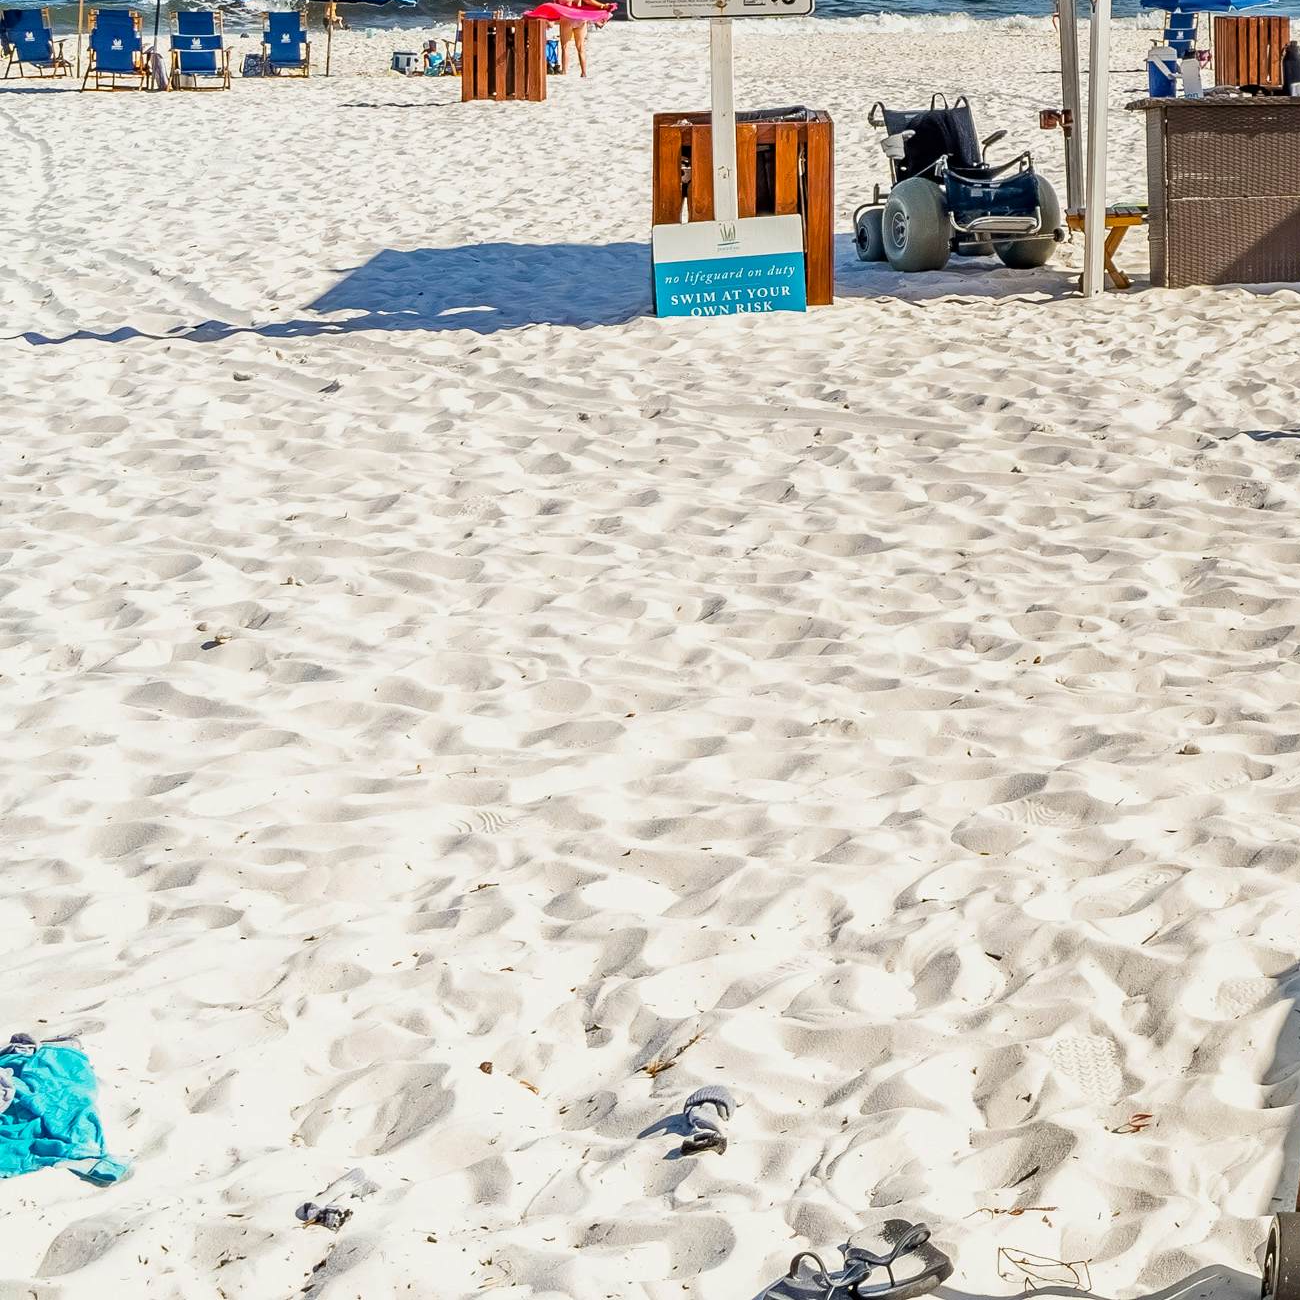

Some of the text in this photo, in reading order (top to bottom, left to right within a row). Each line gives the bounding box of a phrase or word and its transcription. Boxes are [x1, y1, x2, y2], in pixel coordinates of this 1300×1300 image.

[665, 265, 796, 285] no lifeguard on duty
[671, 286, 791, 306] SWIM AT YOUR
[690, 301, 774, 317] OWN RISK
